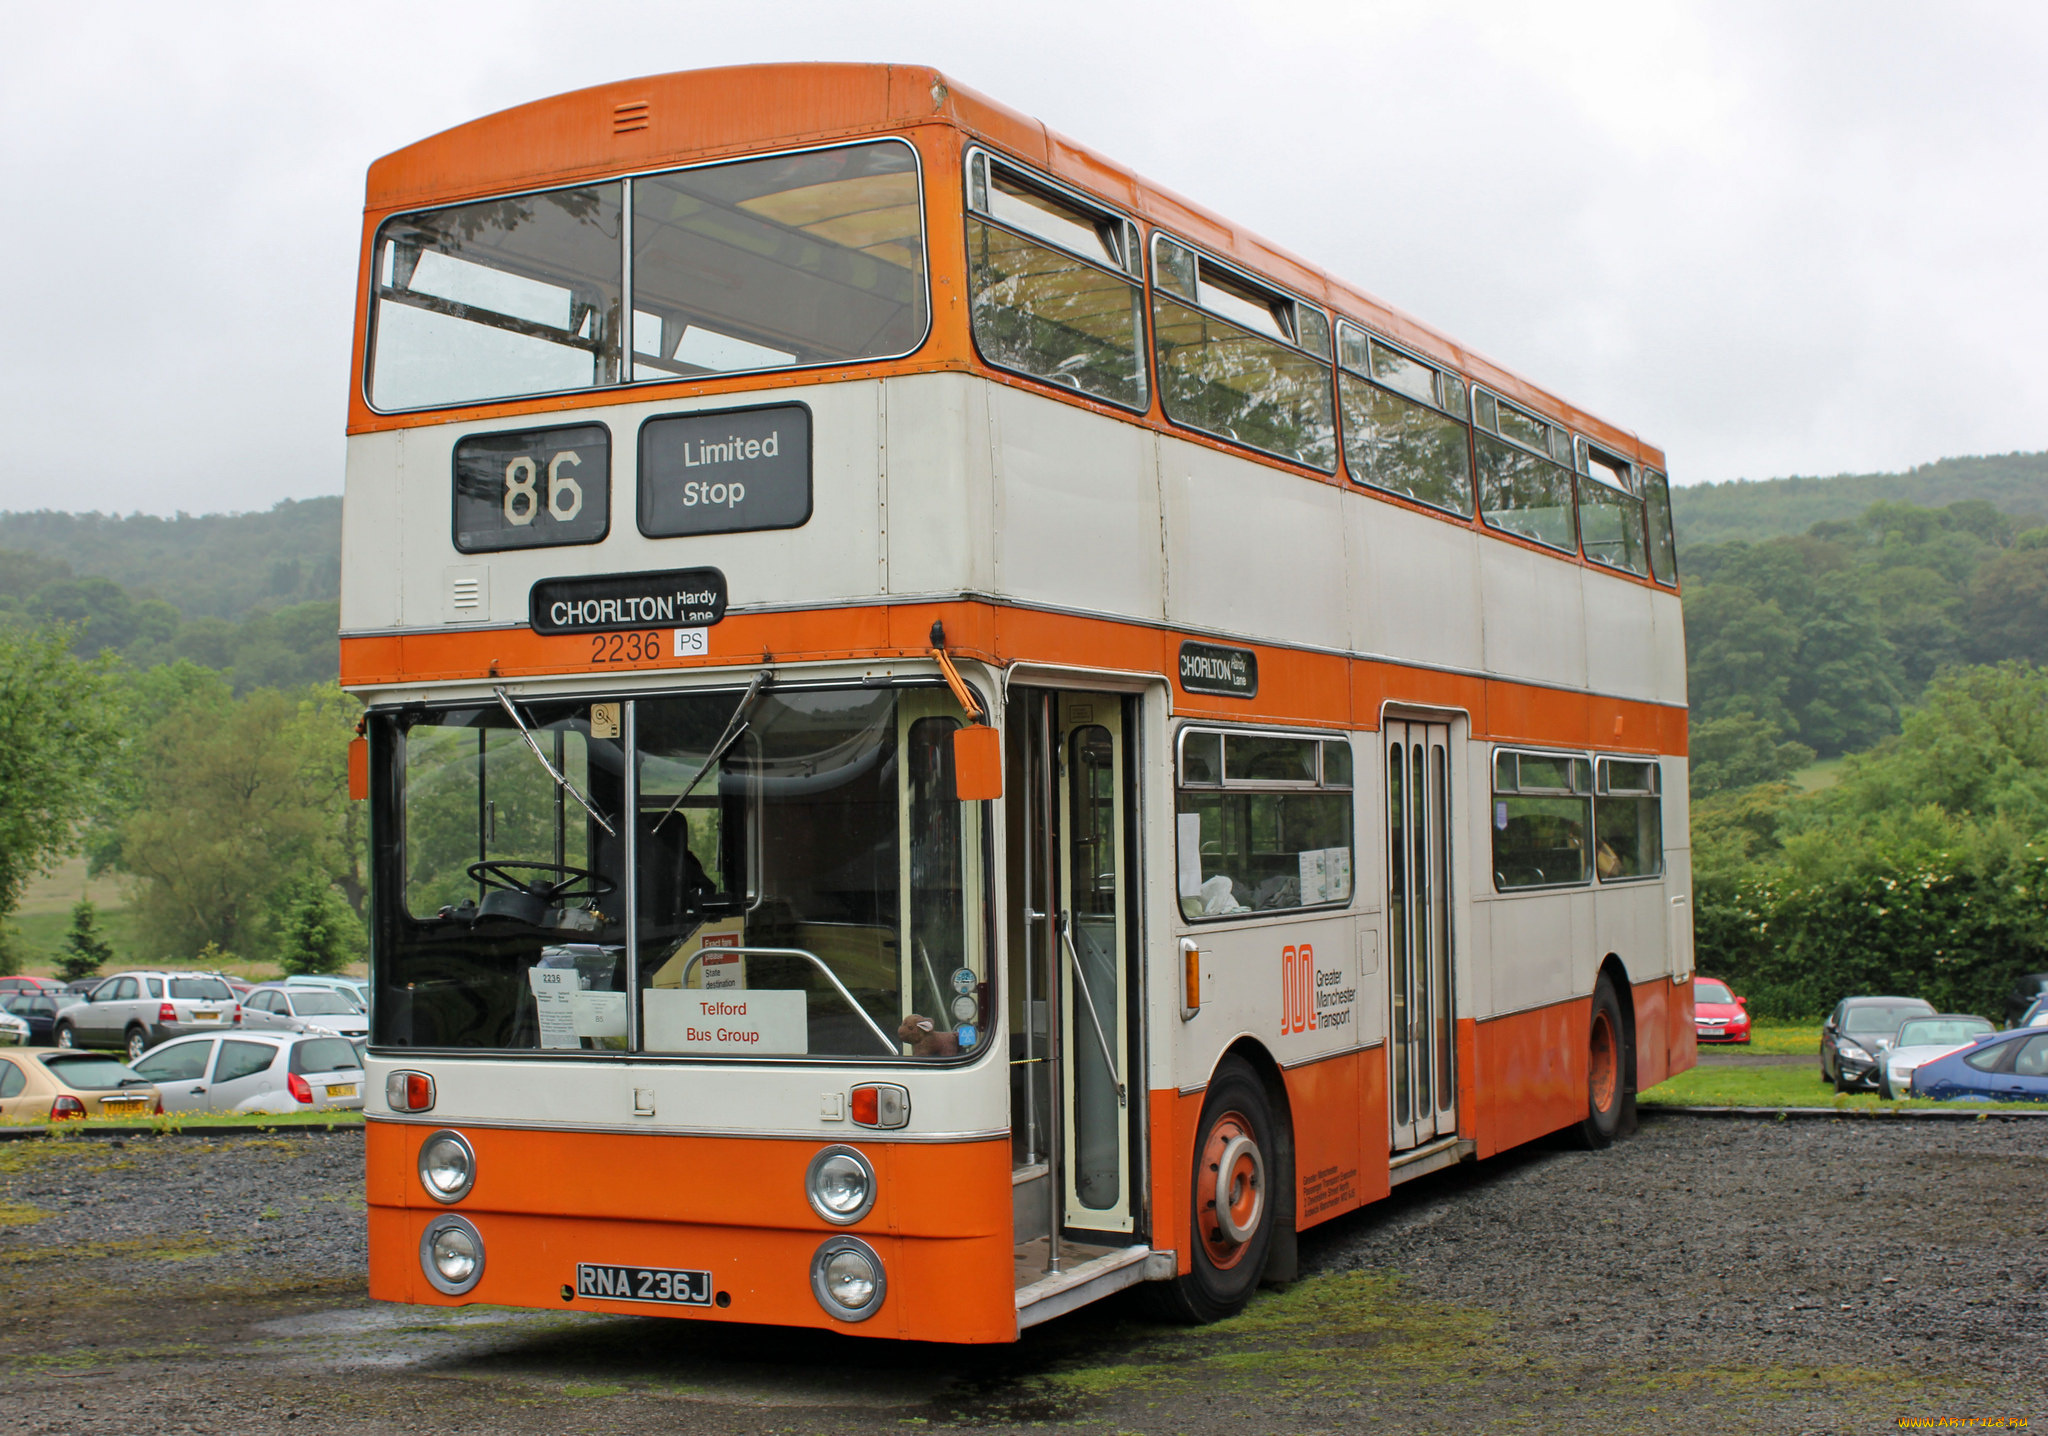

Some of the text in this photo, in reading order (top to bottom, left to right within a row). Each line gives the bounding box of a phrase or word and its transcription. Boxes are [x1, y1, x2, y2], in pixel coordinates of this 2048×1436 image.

[684, 431, 778, 467] Limited
[504, 450, 582, 527] 86
[683, 481, 746, 508] Stop
[676, 590, 717, 606] Hardy
[550, 596, 674, 626] CHORLTON
[681, 610, 714, 622] Lane
[591, 632, 661, 662] 2236
[680, 633, 703, 650] PS
[1180, 655, 1232, 681] CHORLTON
[1232, 674, 1247, 686] Lane
[543, 974, 561, 983] 2236
[705, 968, 721, 978] State
[1316, 969, 1342, 988] Greater
[705, 979, 736, 990] destination
[1316, 987, 1356, 1009] Manchester
[699, 1002, 747, 1017] Telford
[1316, 1008, 1351, 1030] Transport
[686, 1028, 760, 1046] Bus Group
[579, 1266, 710, 1302] RNA 236J
